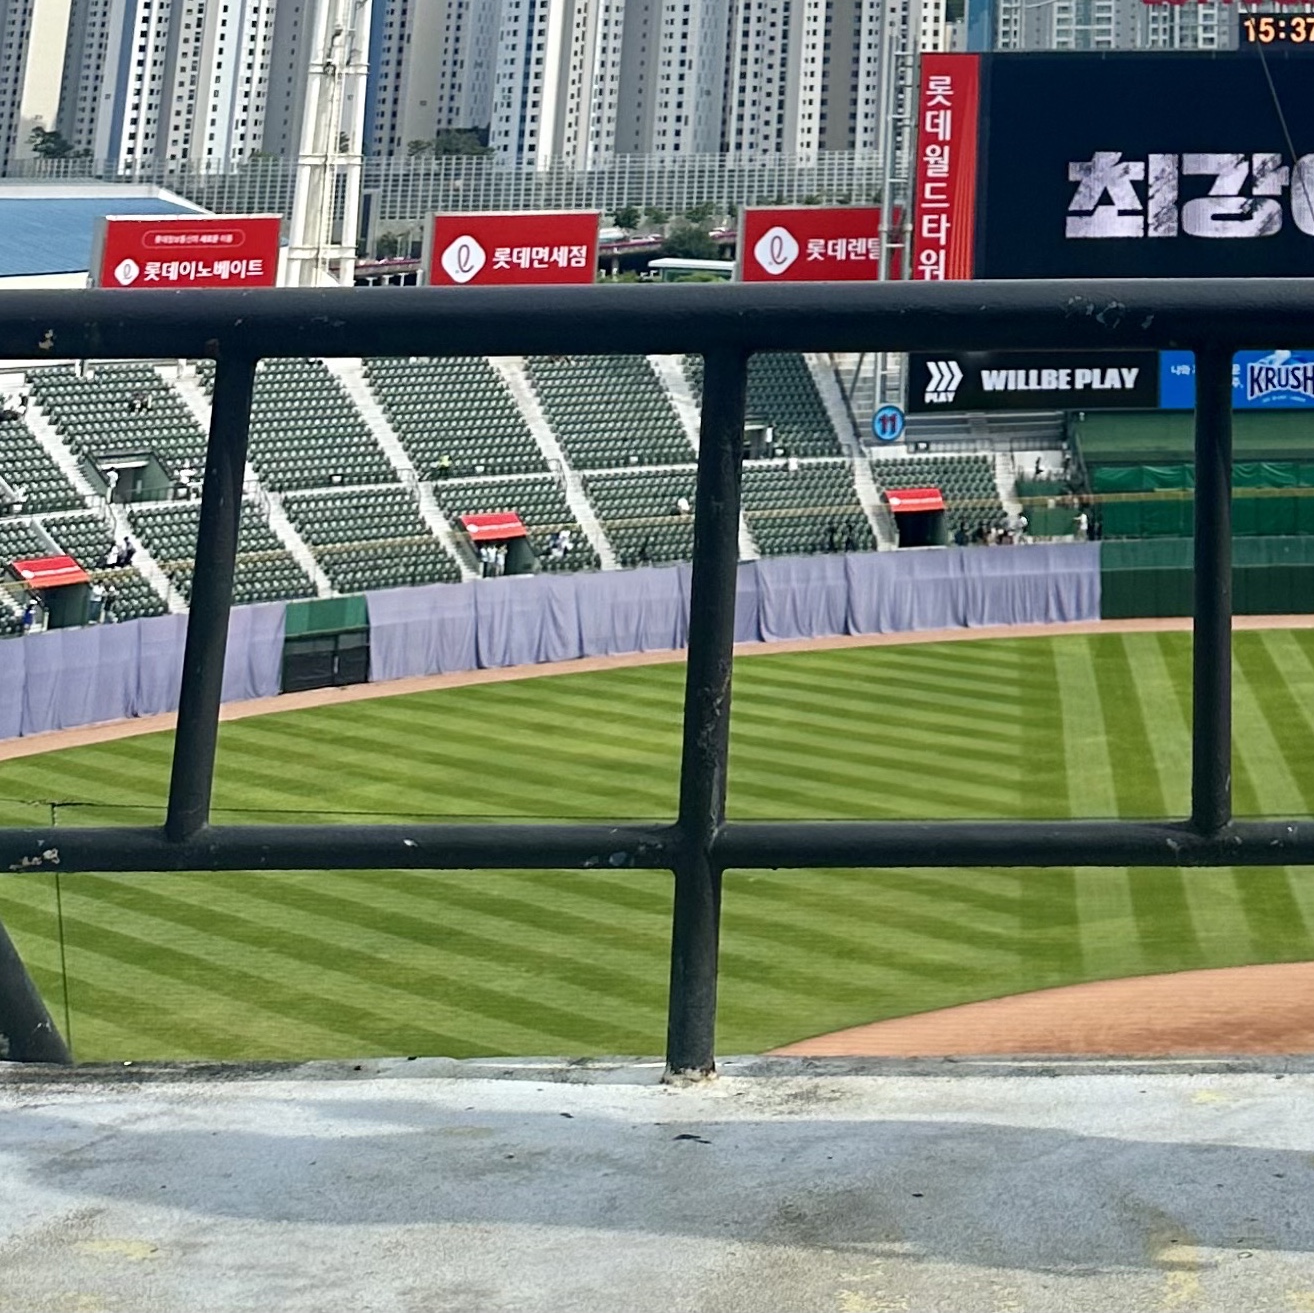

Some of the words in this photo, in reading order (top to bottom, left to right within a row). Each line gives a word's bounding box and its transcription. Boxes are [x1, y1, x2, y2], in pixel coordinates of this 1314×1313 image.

[492, 245, 588, 269] 롯데면세점
[144, 259, 264, 282] 롯데이노베이트
[981, 368, 1072, 391] WILLBE
[1074, 368, 1139, 389] PLAY
[925, 392, 955, 403] PLAY
[878, 413, 898, 435] 11
